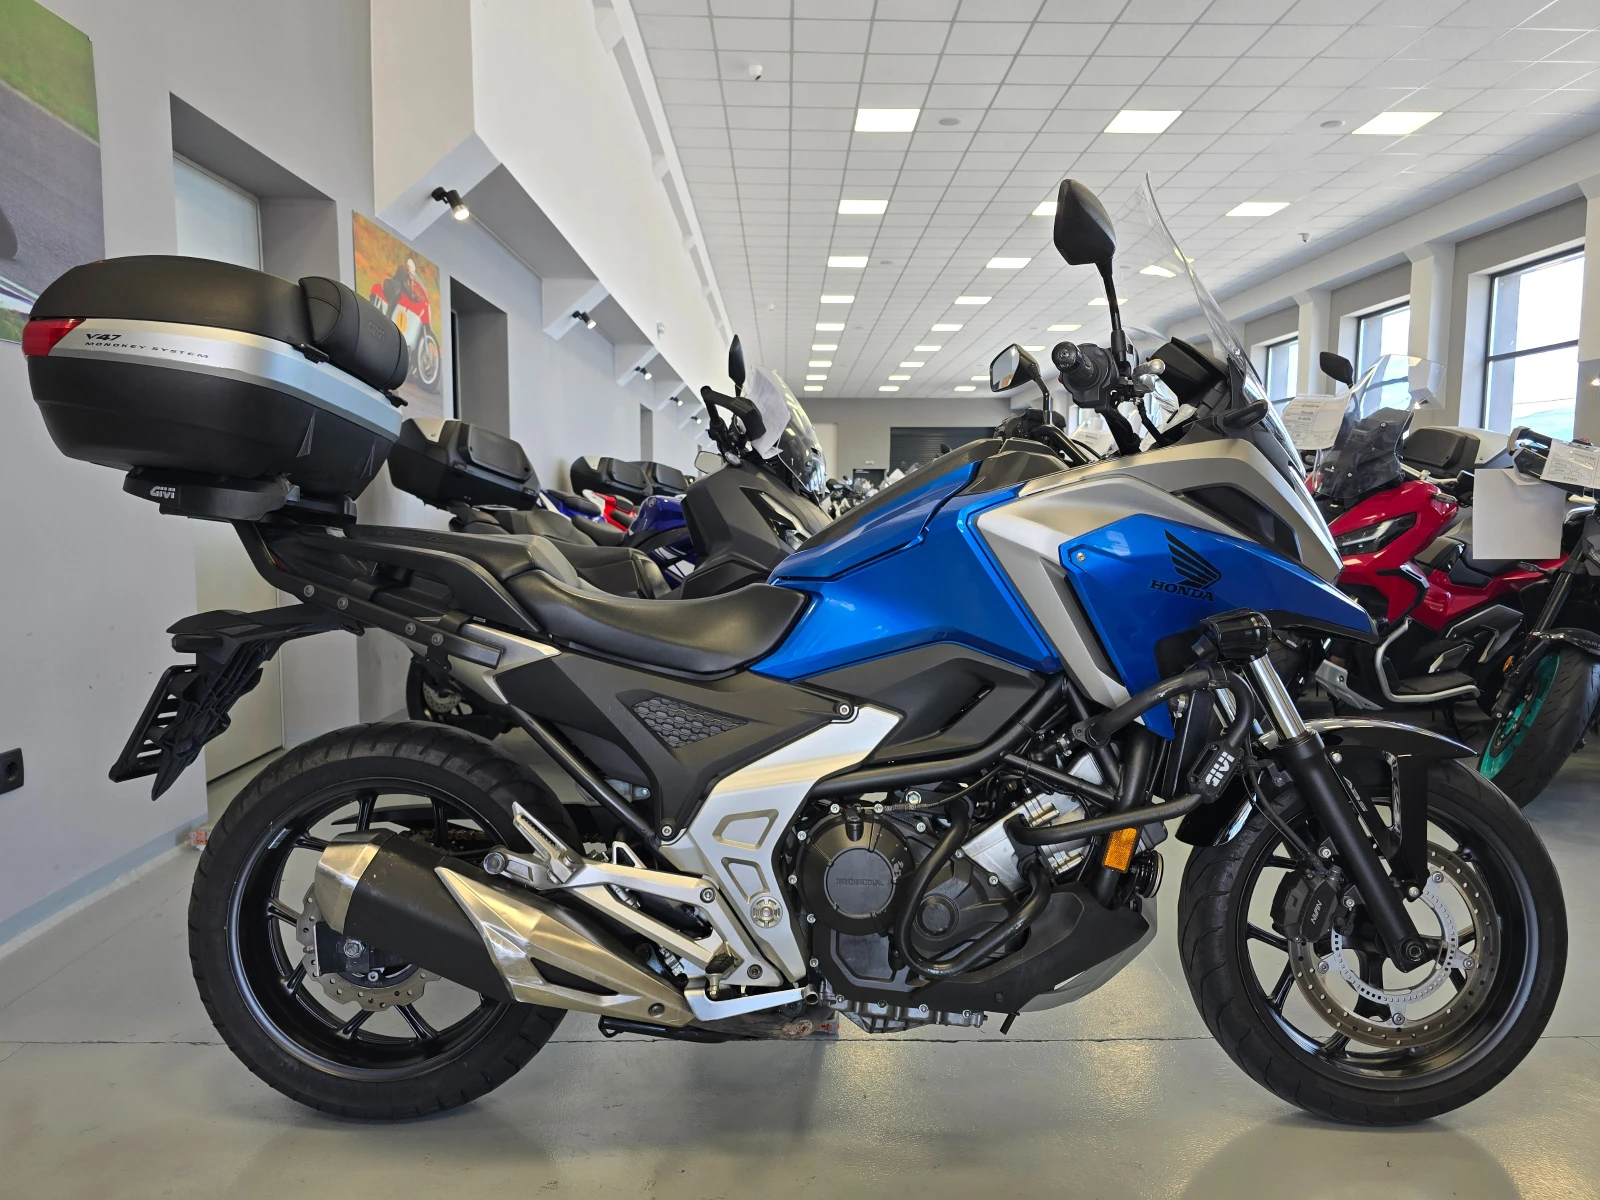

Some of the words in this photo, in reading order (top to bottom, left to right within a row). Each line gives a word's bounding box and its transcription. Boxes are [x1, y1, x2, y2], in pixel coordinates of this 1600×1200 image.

[86, 333, 122, 341] V47
[85, 341, 147, 349] MONOKEY
[151, 346, 209, 359] SYSTEM
[150, 485, 176, 499] GIVI
[1149, 579, 1215, 602] HONDA
[1205, 751, 1235, 787] GIVI
[836, 877, 885, 887] HONDA
